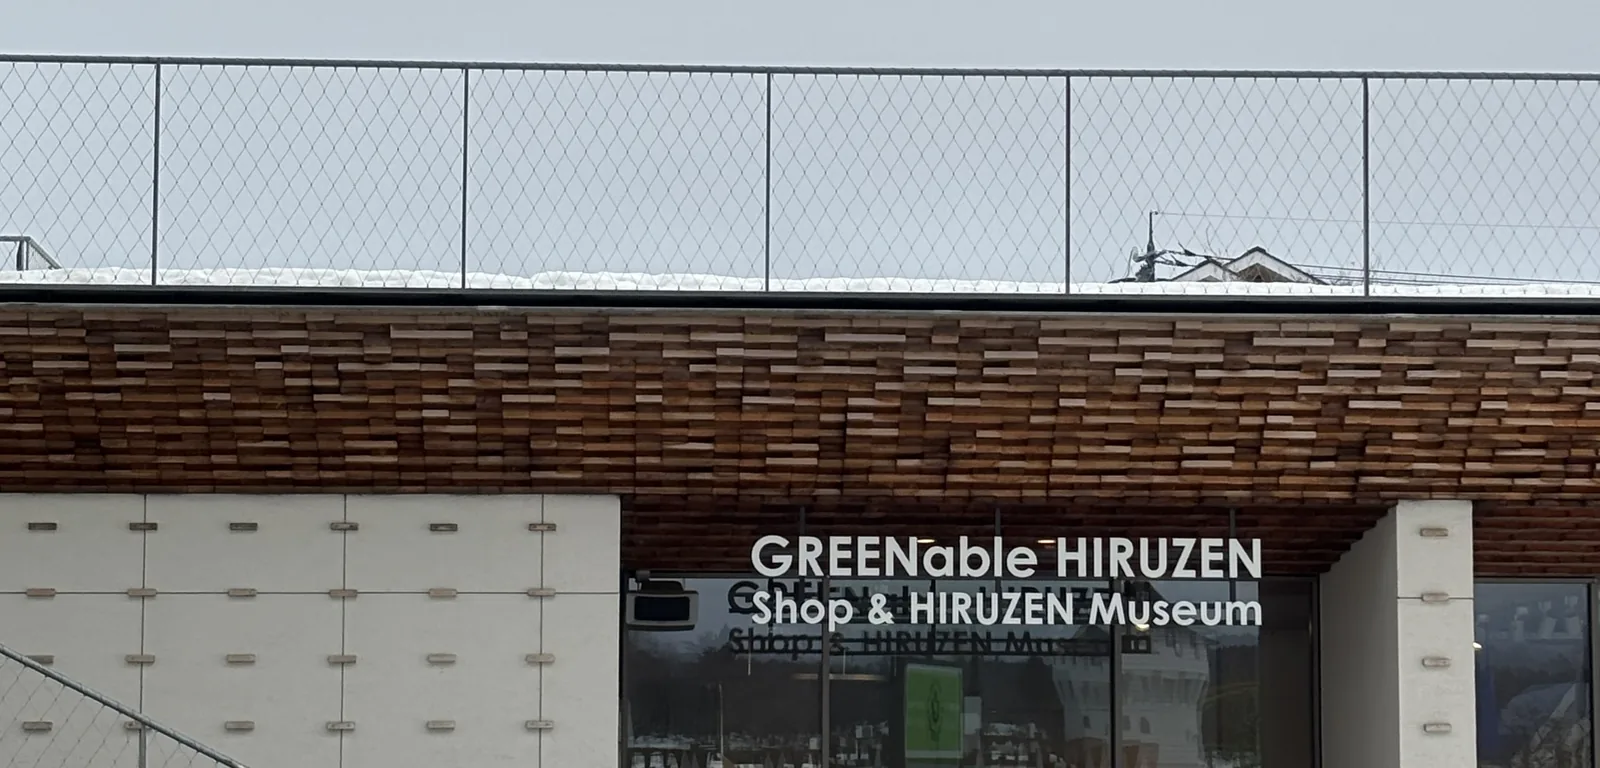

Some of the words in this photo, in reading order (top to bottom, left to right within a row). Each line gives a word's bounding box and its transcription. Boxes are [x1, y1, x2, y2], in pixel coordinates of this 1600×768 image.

[751, 535, 1038, 578] GREENable
[1057, 536, 1263, 579] HIRUZEN
[750, 590, 854, 632] Shop
[867, 592, 895, 626] &
[910, 591, 1075, 626] HIRUZEN
[1088, 591, 1262, 626] Museum
